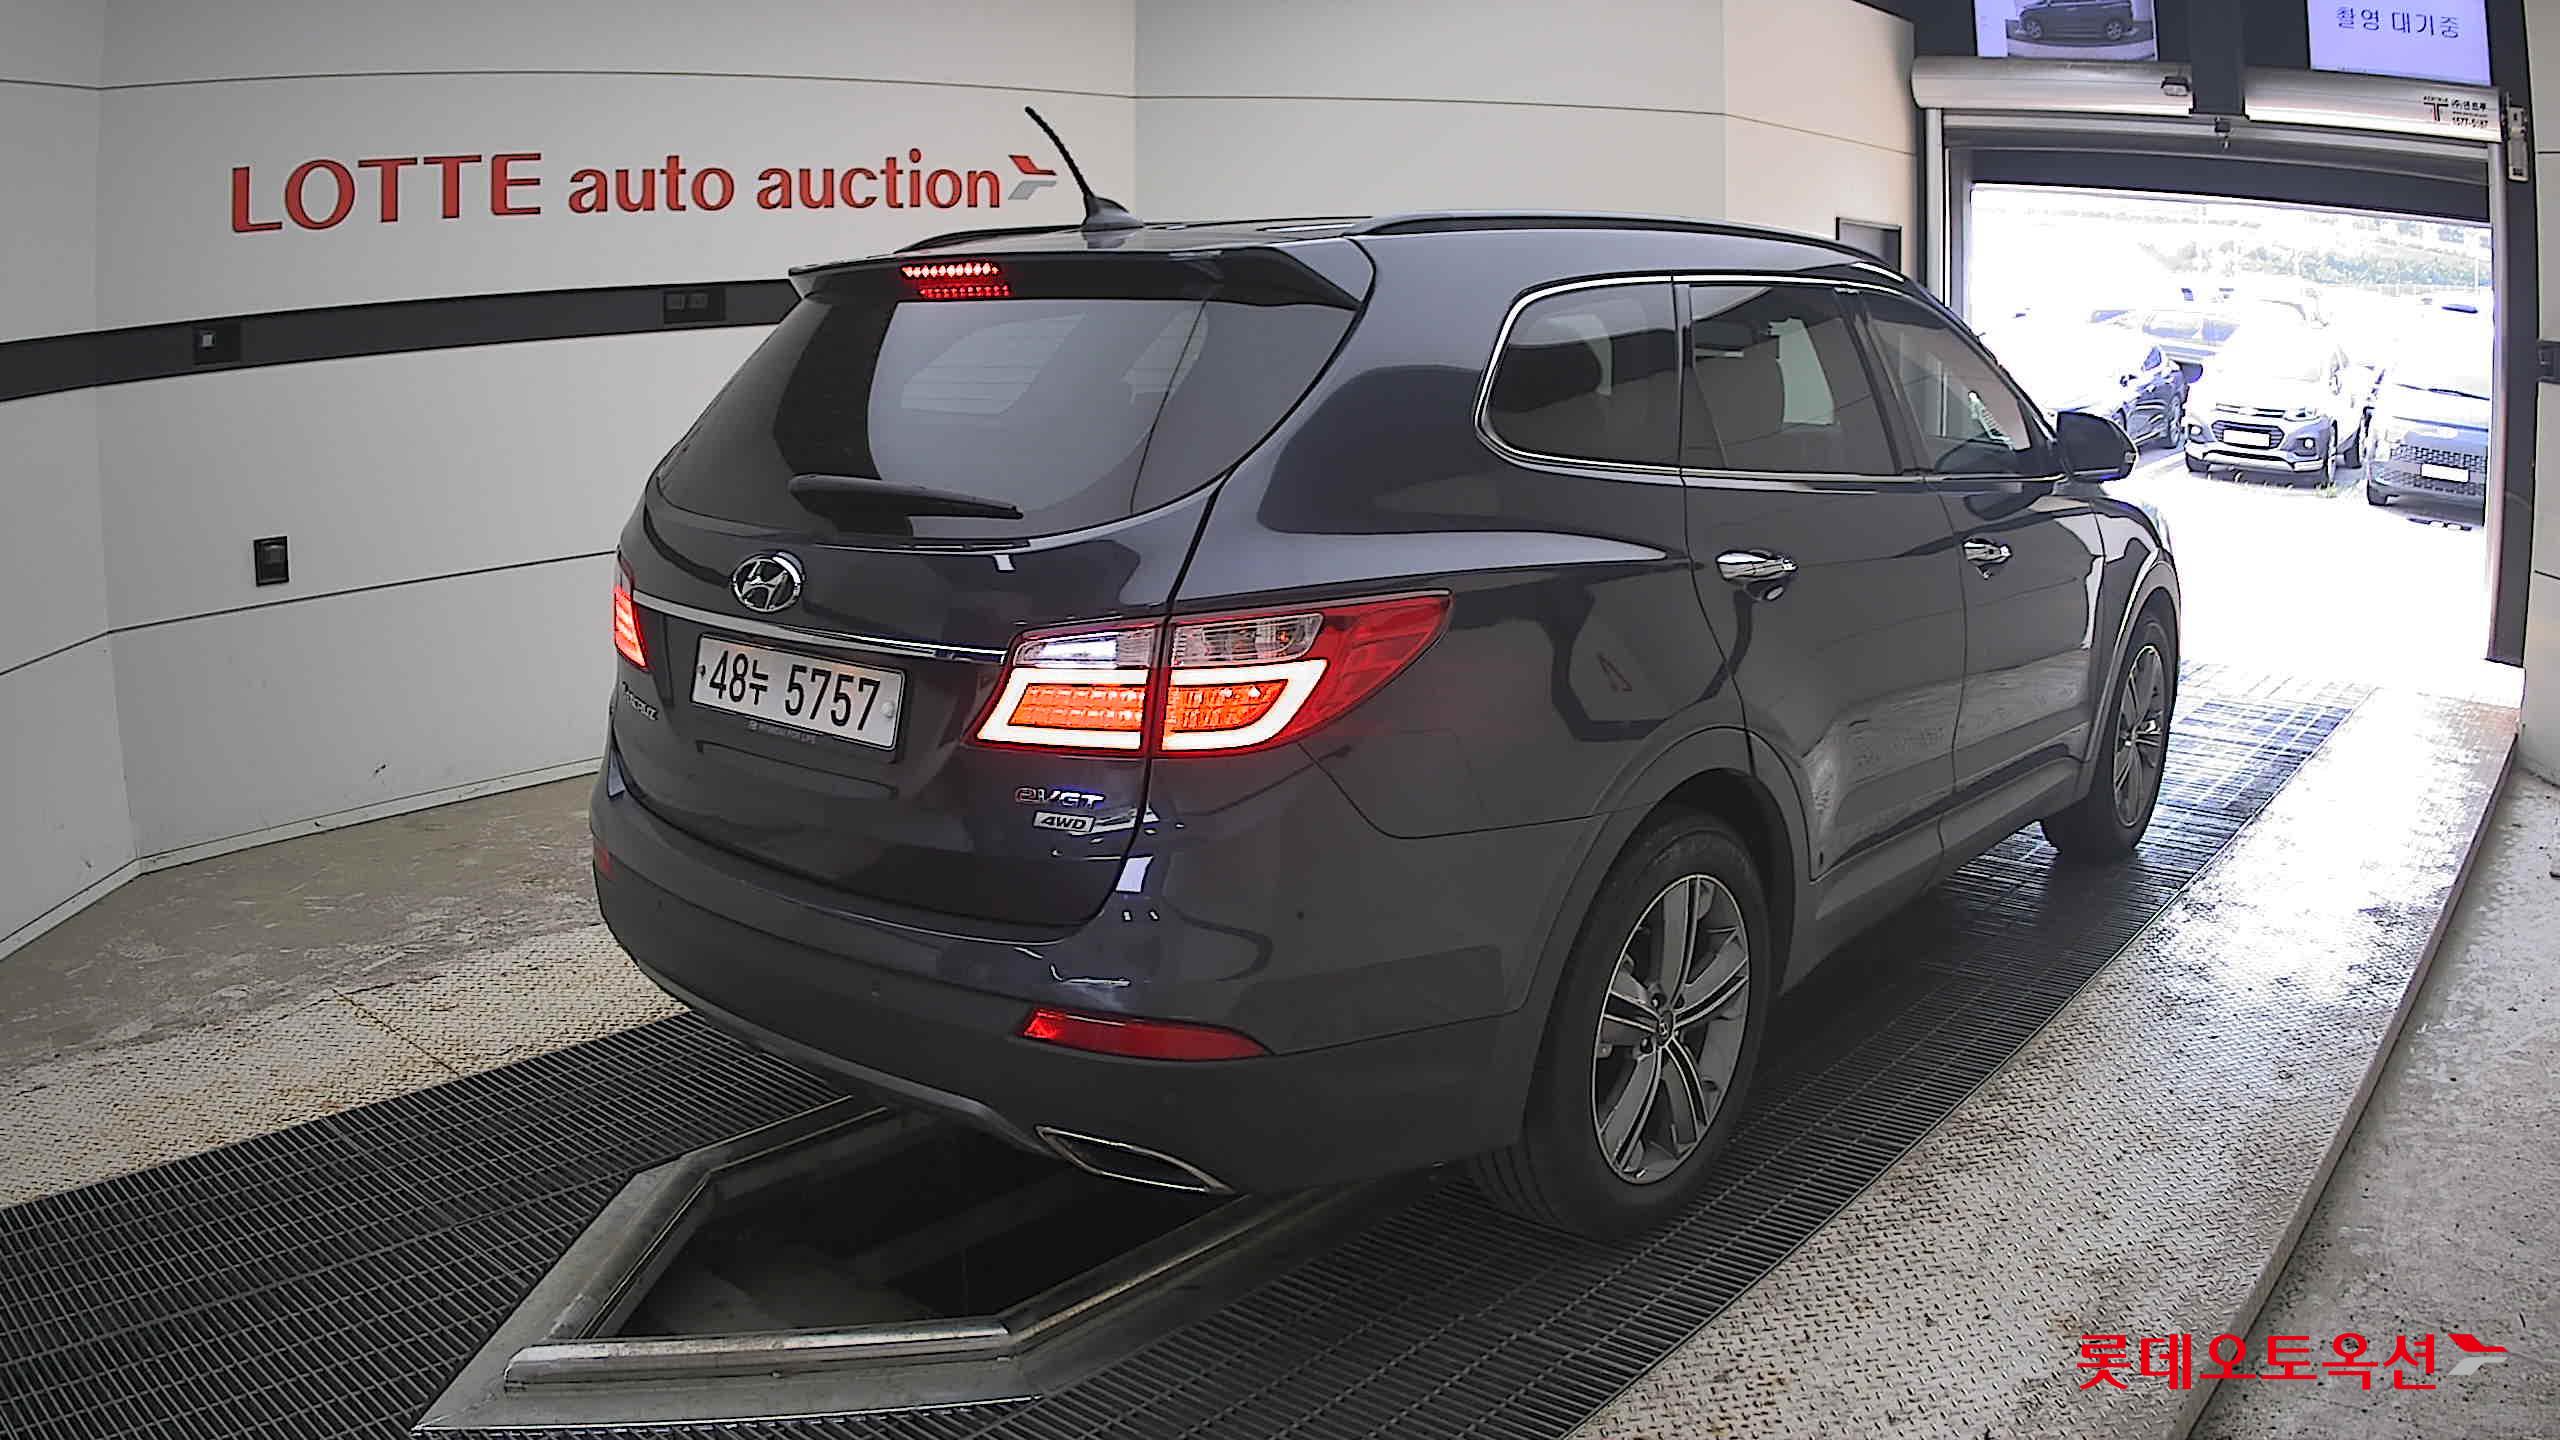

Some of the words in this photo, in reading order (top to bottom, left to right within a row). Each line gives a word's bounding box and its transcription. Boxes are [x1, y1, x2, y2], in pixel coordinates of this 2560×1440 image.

[2391, 12, 2460, 39] 대기중
[232, 153, 541, 233] LOTTE
[568, 155, 735, 214] auto
[757, 148, 1000, 209] auction
[709, 650, 769, 705] 48누
[785, 664, 881, 731] 5757
[1041, 816, 1087, 830] AWD
